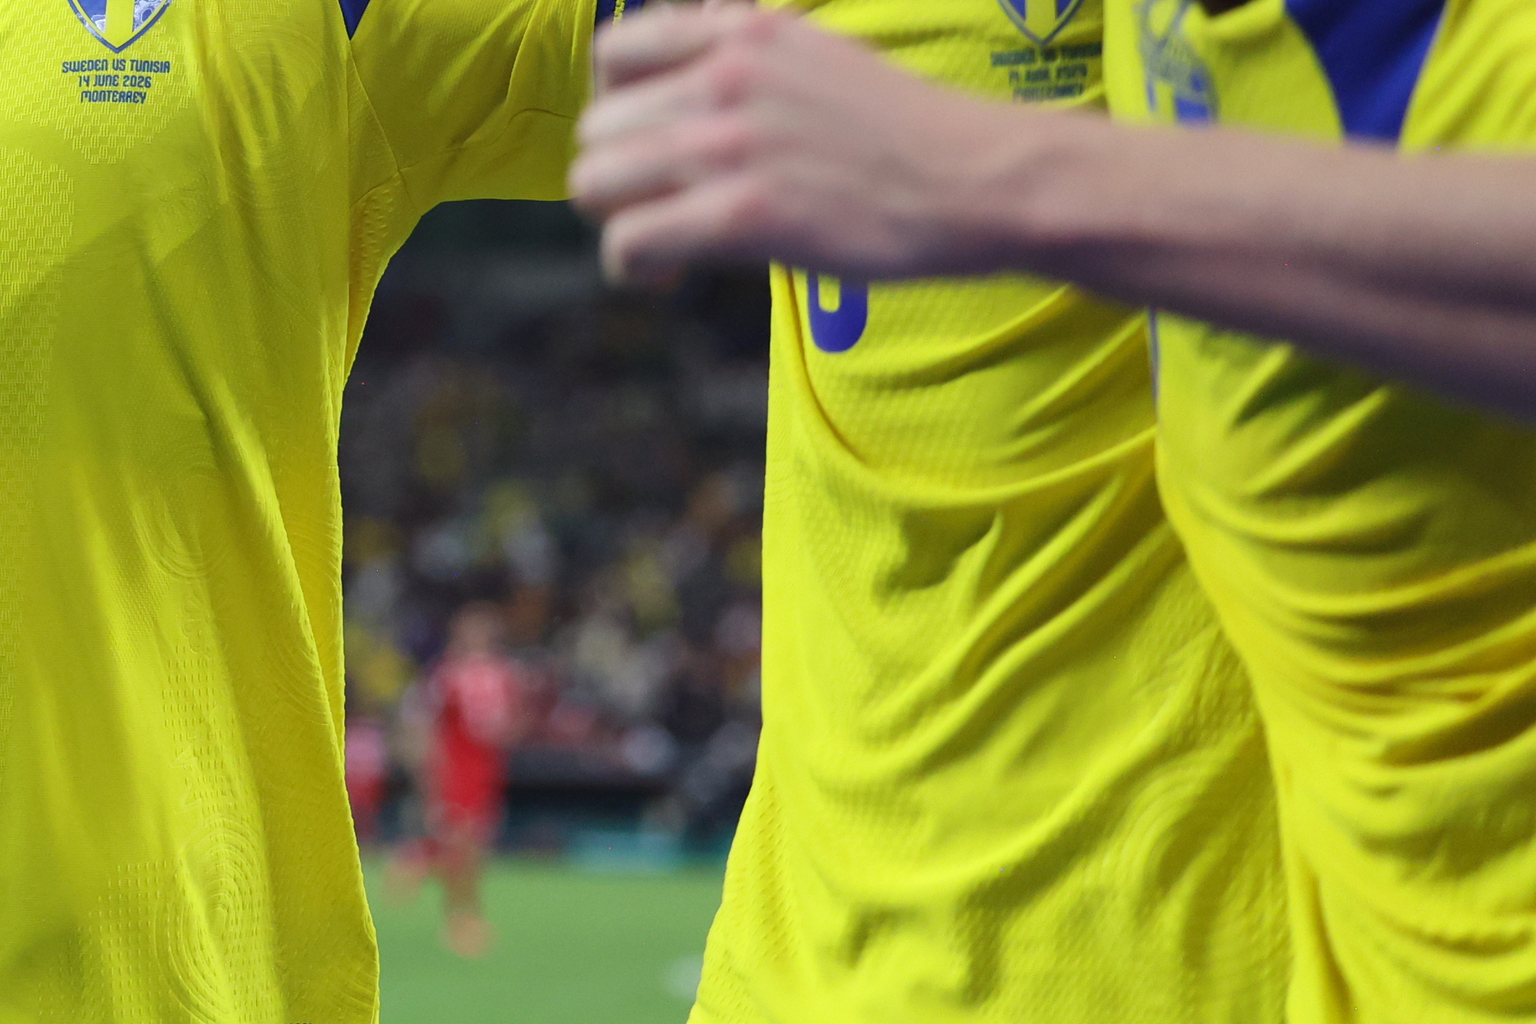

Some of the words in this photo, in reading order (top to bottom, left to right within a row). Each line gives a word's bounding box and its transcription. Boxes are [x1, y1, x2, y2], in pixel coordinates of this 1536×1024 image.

[62, 59, 108, 73] SWEDEN
[130, 59, 170, 73] TUNISIA
[79, 76, 90, 87] 14
[93, 75, 119, 87] JUNE
[123, 75, 152, 88] 2026
[81, 91, 146, 104] MONTERREY
